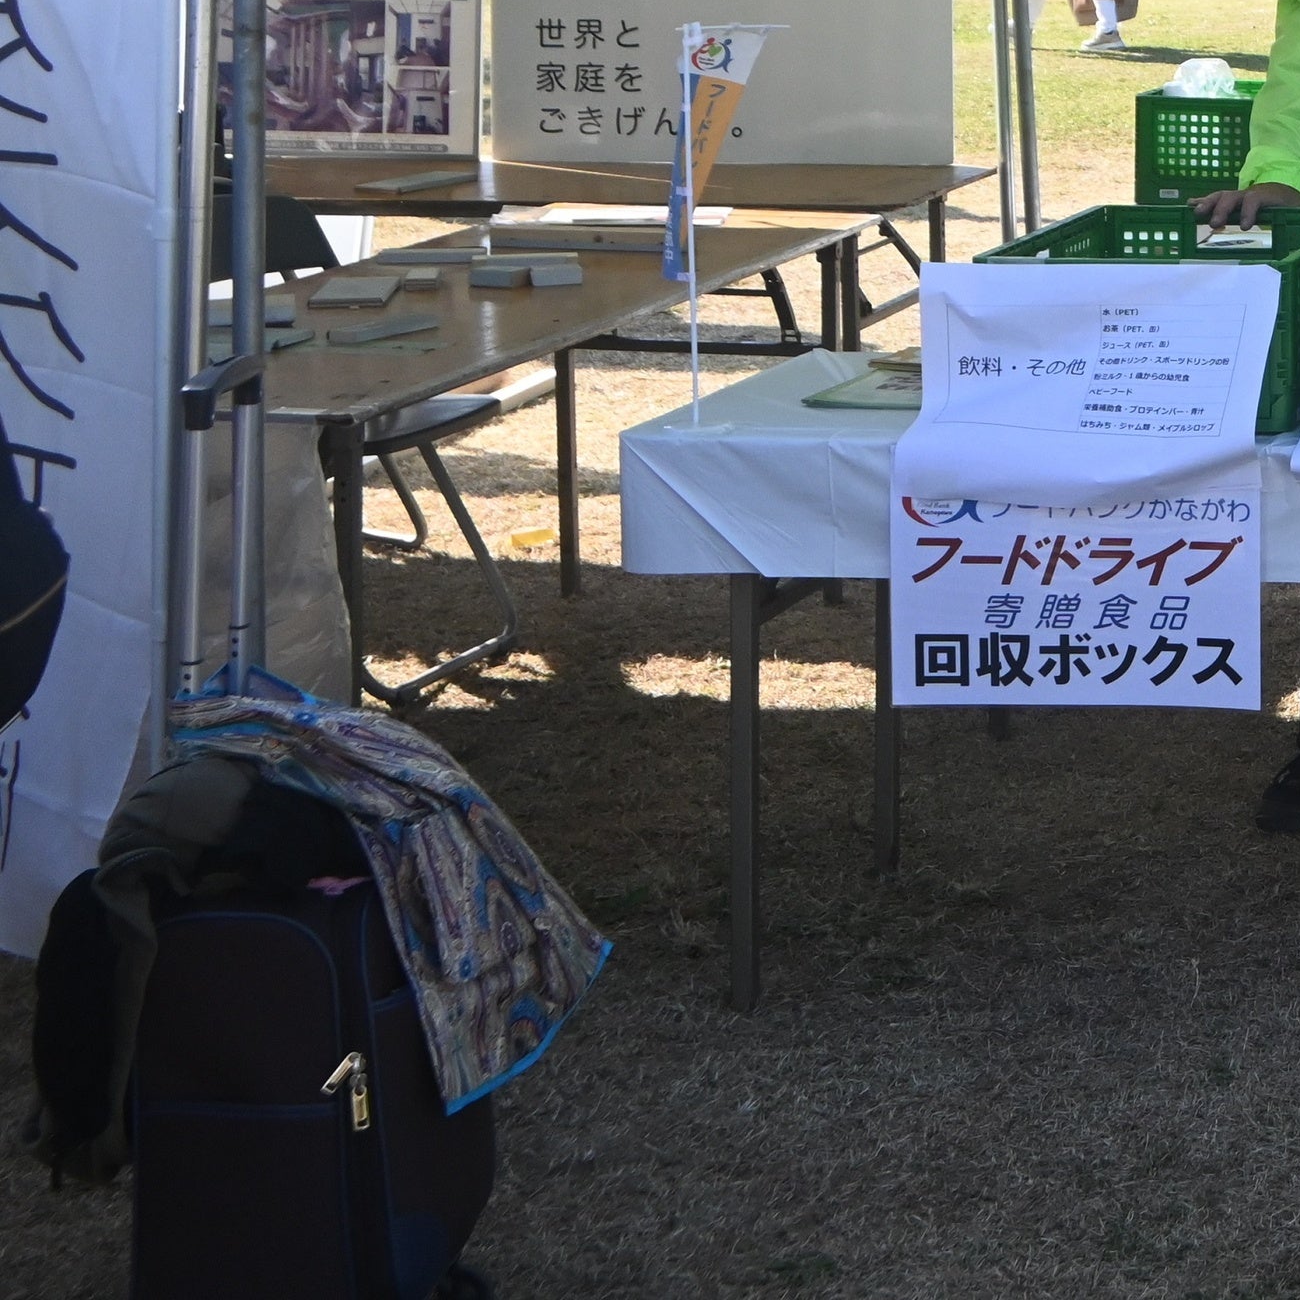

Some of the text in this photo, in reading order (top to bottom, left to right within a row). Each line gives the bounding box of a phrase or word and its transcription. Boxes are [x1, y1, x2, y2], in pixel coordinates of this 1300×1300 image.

[535, 18, 640, 49] 世界と
[535, 63, 643, 93] 家庭を
[958, 356, 1087, 378] 飲料・その他
[912, 534, 1244, 587] フードドライブ
[984, 593, 1191, 630] 寄贈食品
[914, 631, 1243, 688] 回収ボックス
